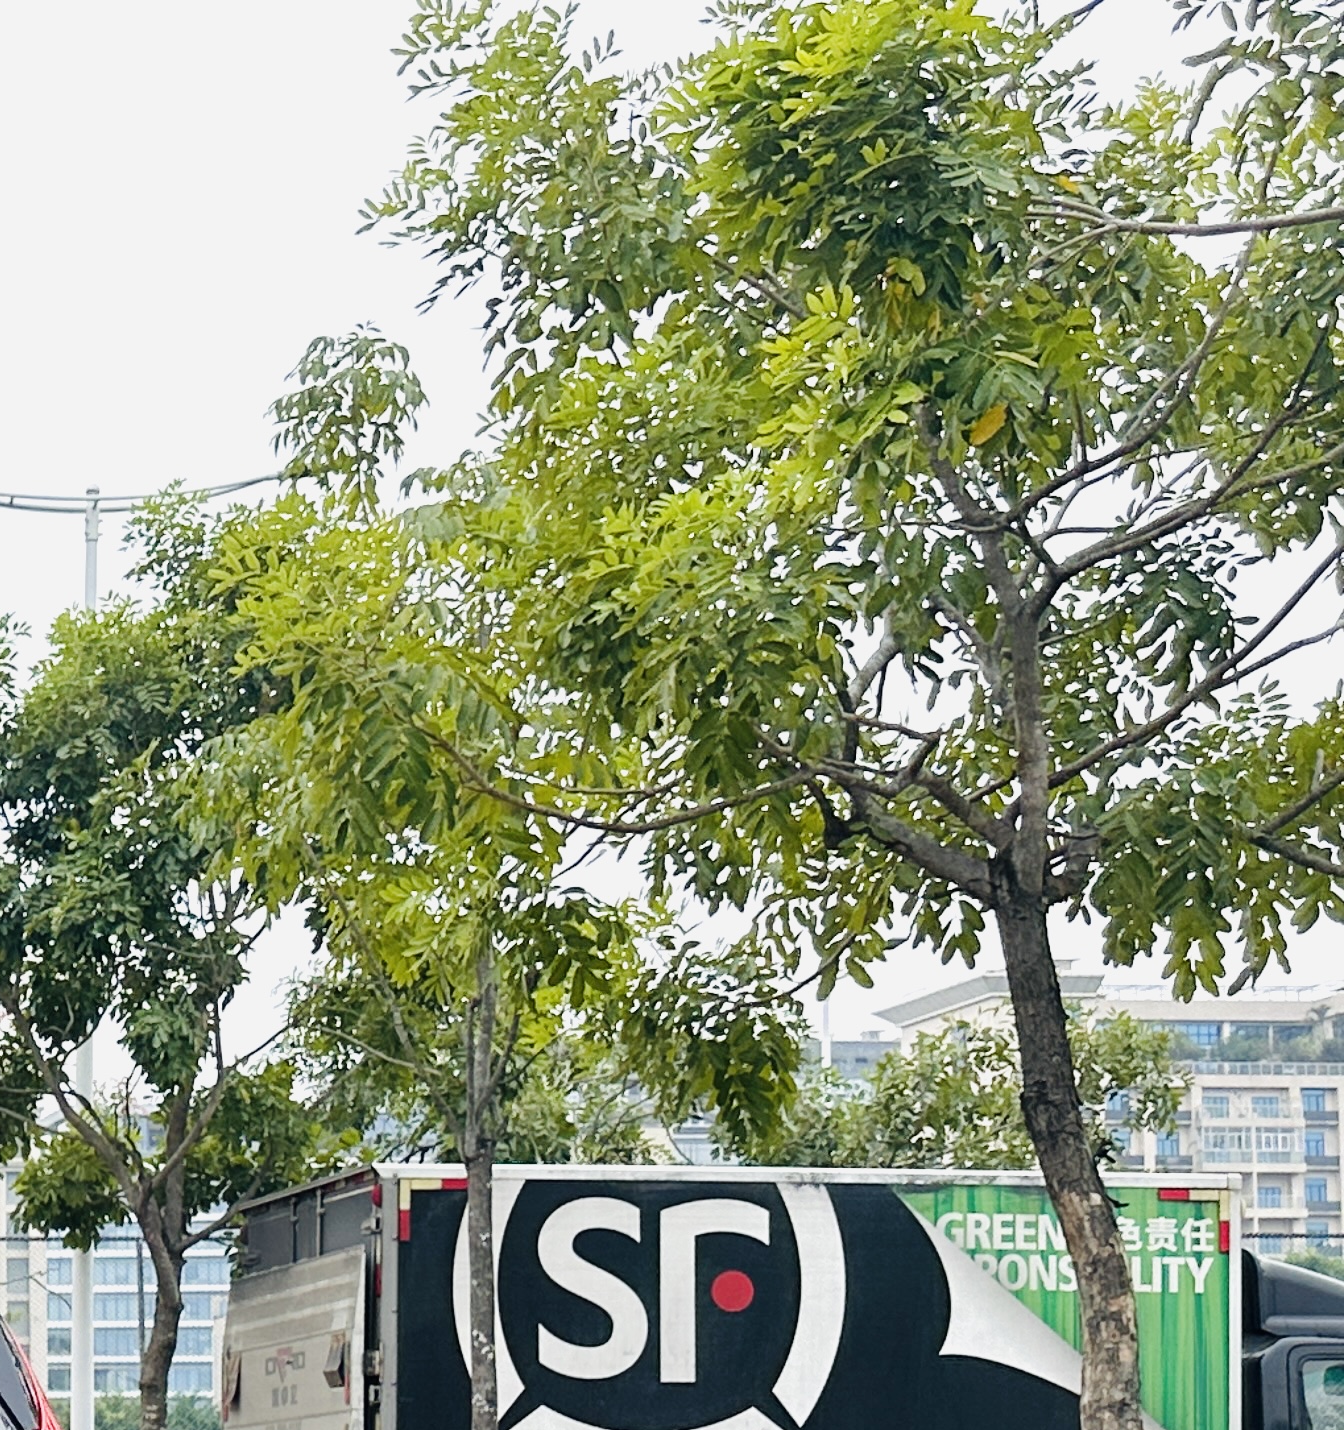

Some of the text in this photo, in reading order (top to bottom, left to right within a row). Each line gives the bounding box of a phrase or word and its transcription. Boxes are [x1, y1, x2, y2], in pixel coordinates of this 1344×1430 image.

[935, 1212, 1215, 1252] GREEN 色责任
[537, 1196, 770, 1383] SF
